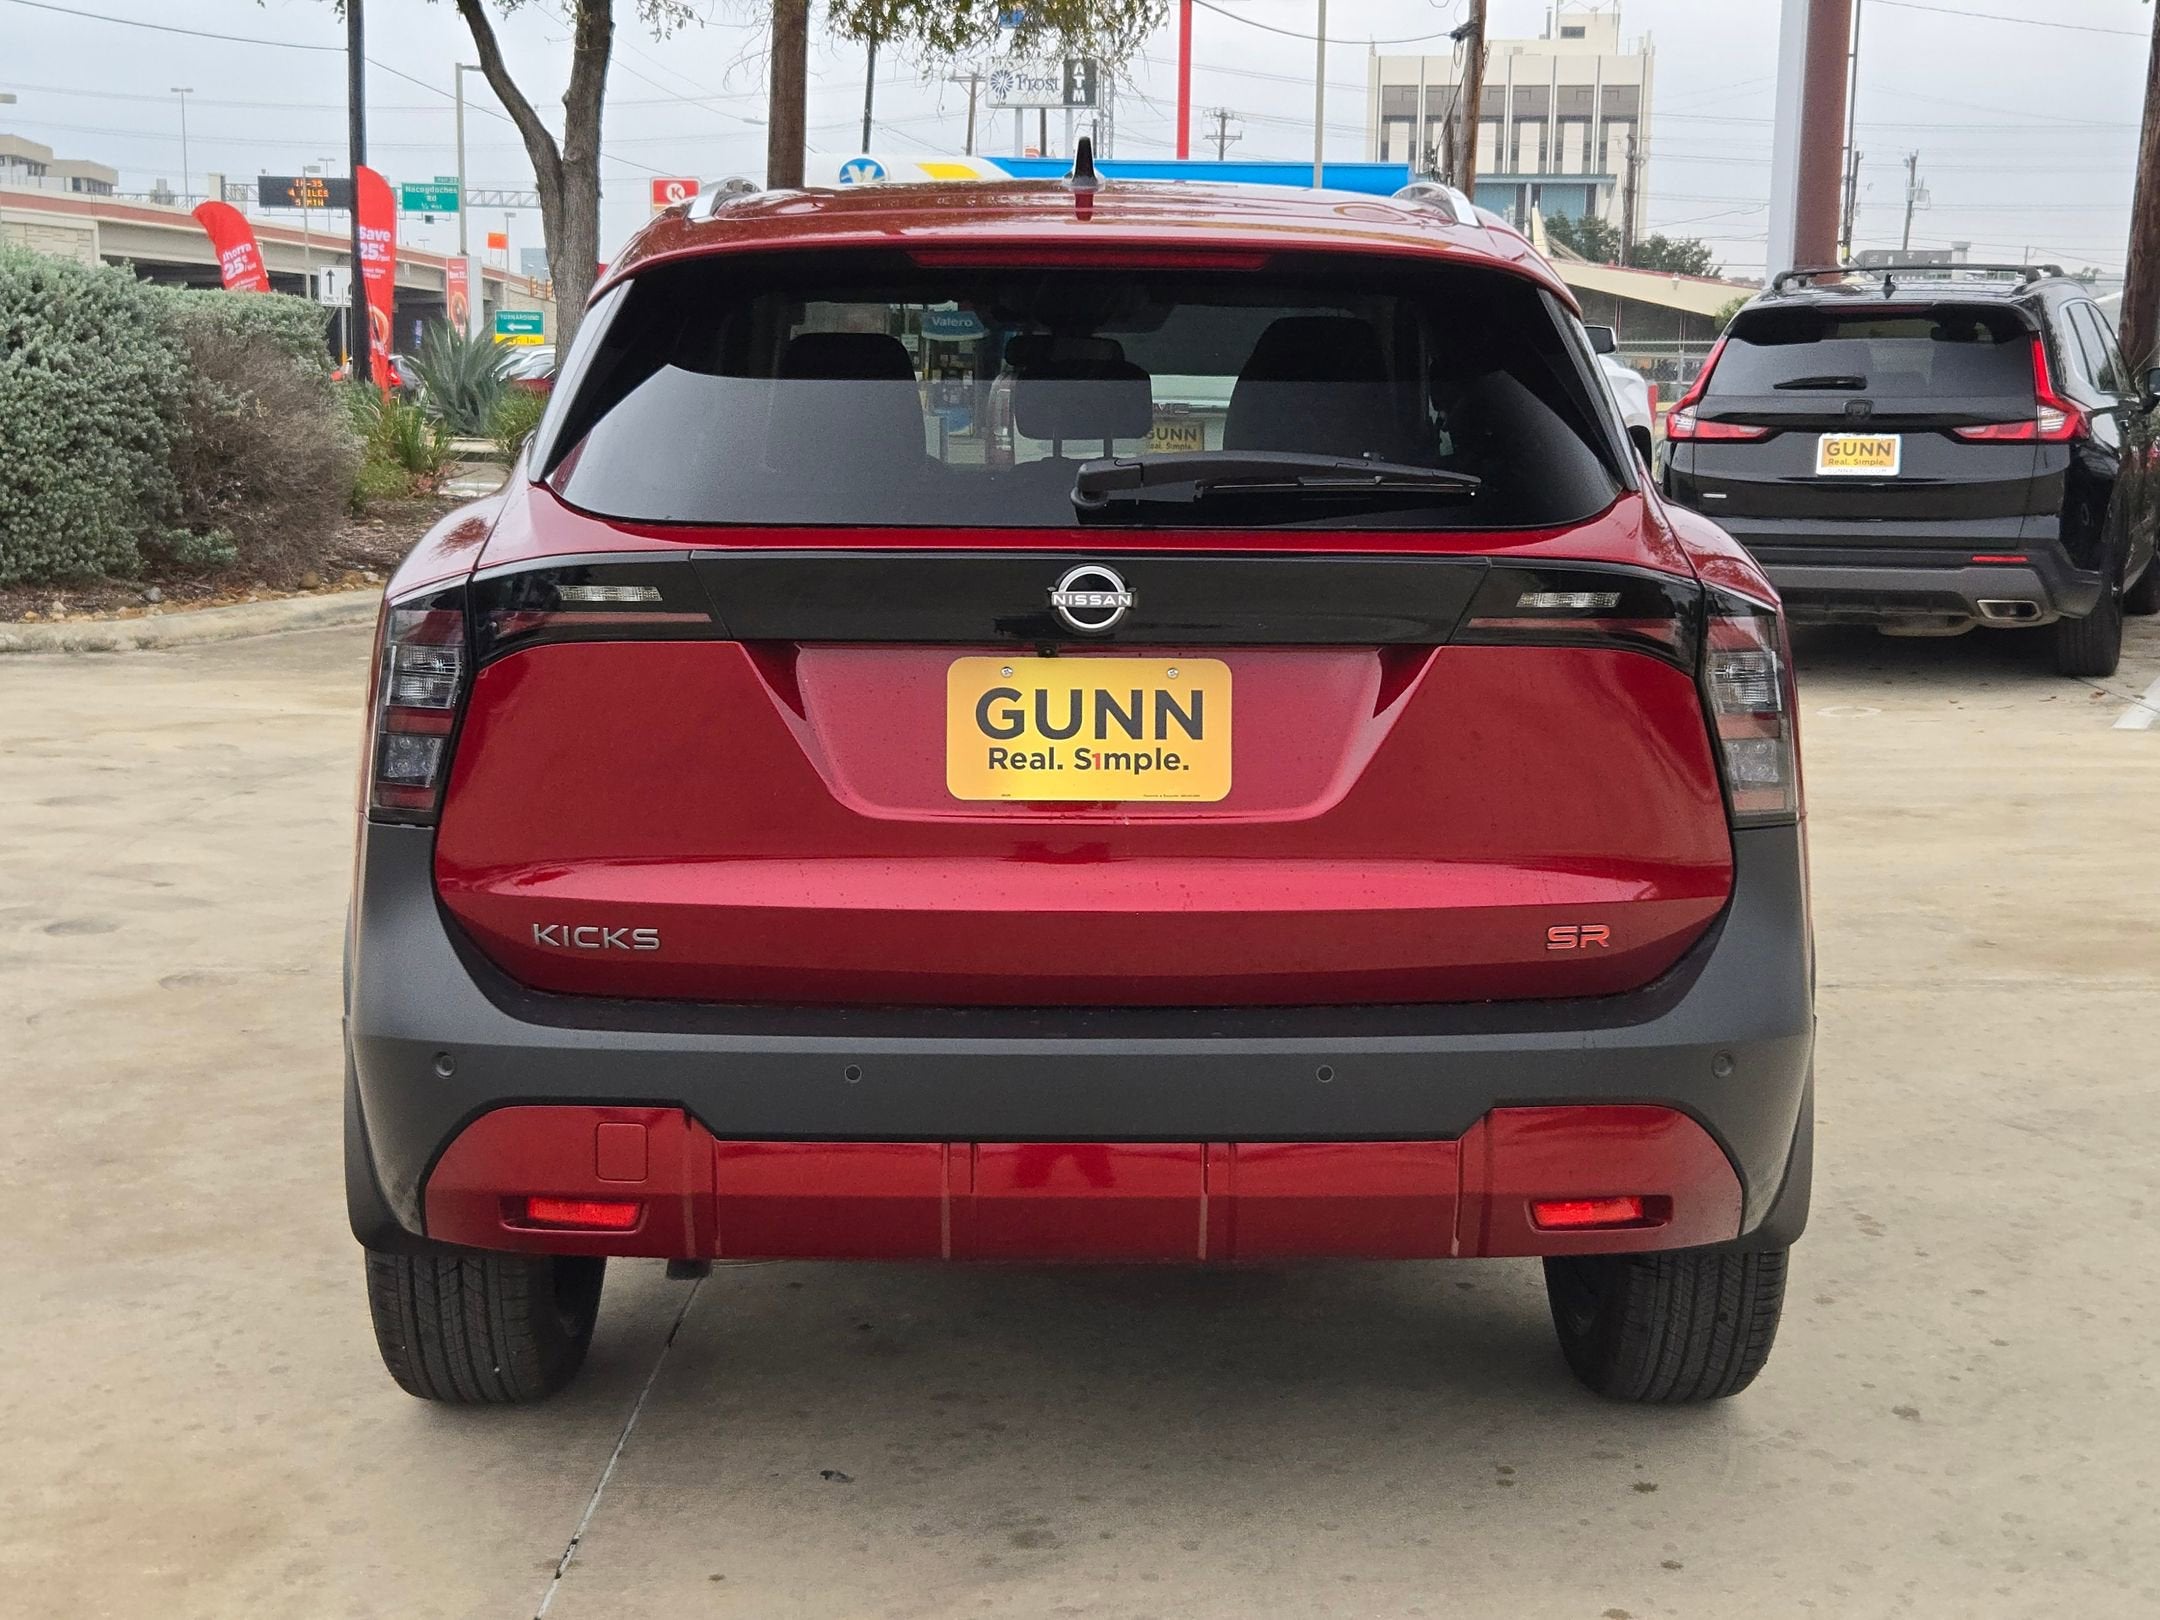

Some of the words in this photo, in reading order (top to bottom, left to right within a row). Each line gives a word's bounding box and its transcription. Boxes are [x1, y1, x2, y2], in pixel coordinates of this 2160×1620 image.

[1015, 74, 1060, 91] Frost
[1073, 62, 1086, 102] ATM
[405, 185, 458, 195] Nacogdoches
[671, 186, 683, 200] K
[359, 225, 392, 243] Save
[931, 315, 974, 327] Valero
[1826, 441, 1892, 457] GUNN
[1827, 458, 1850, 466] Real.
[1053, 594, 1131, 606] NISSAN
[975, 686, 1204, 741] GUNN
[988, 746, 1064, 771] Real.
[533, 923, 661, 951] KICKS
[1546, 924, 1611, 950] SR
